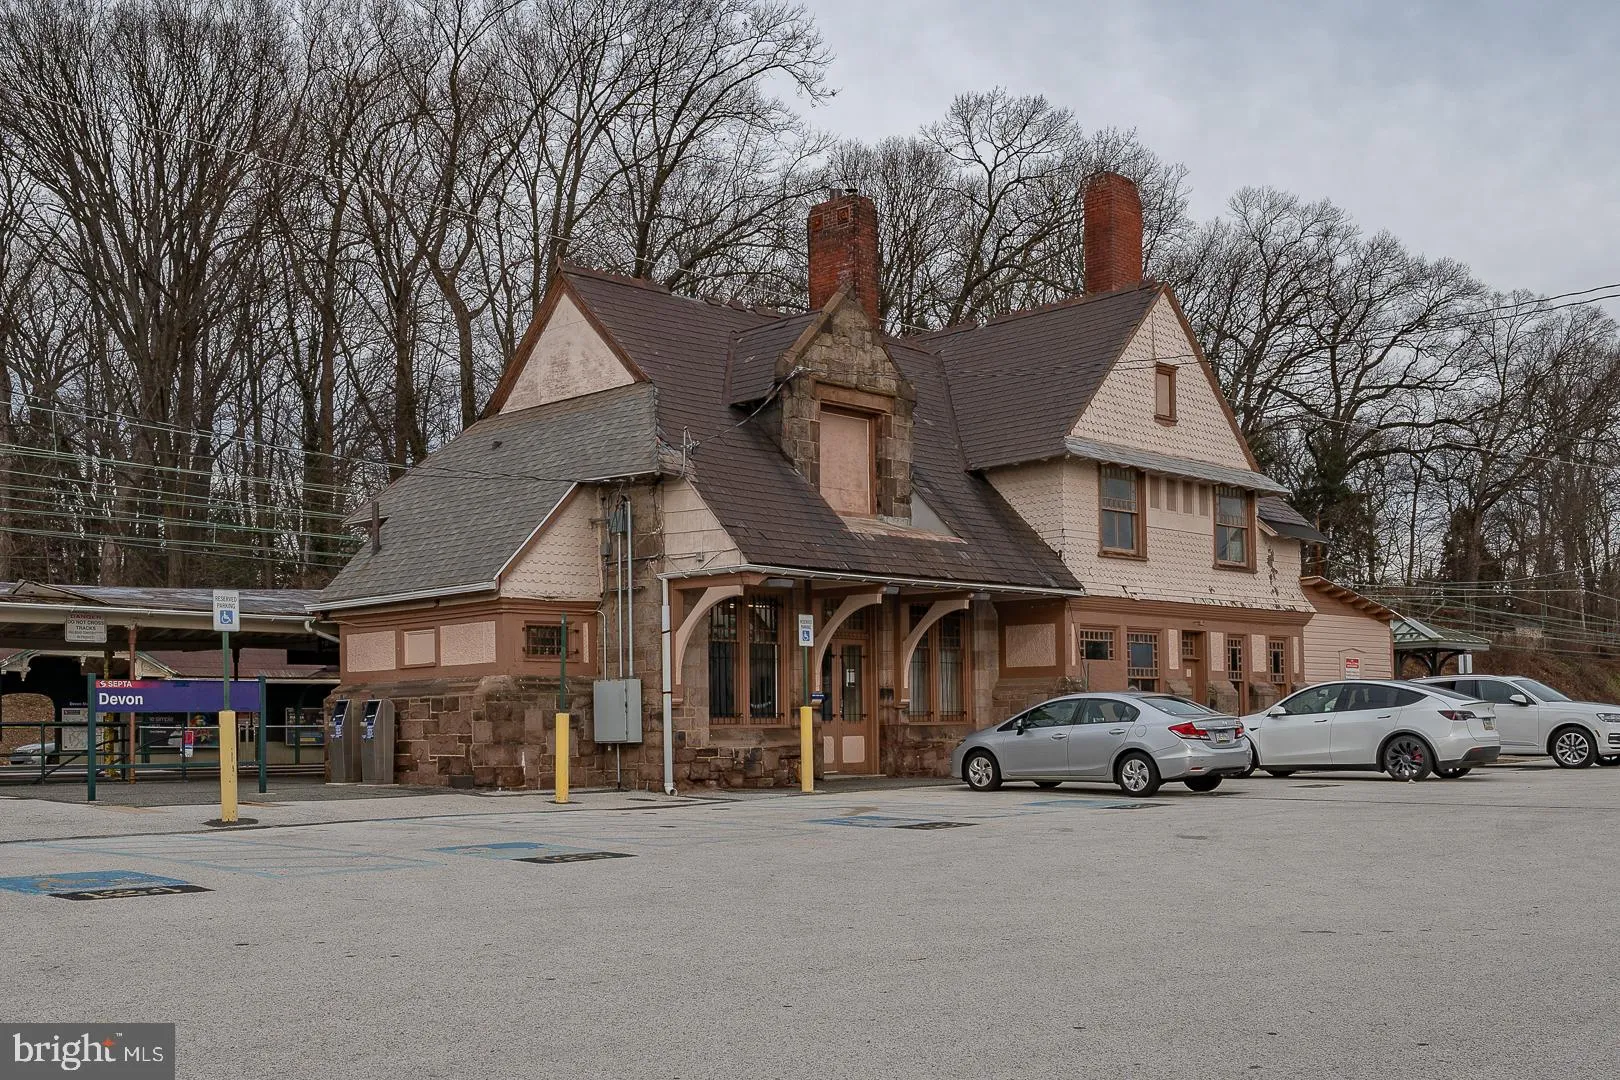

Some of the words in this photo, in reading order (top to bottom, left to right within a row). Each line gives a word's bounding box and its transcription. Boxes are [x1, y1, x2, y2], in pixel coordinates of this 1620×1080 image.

[215, 595, 238, 603] RESERVED
[108, 680, 133, 688] SEPTA
[98, 692, 144, 705] Devon
